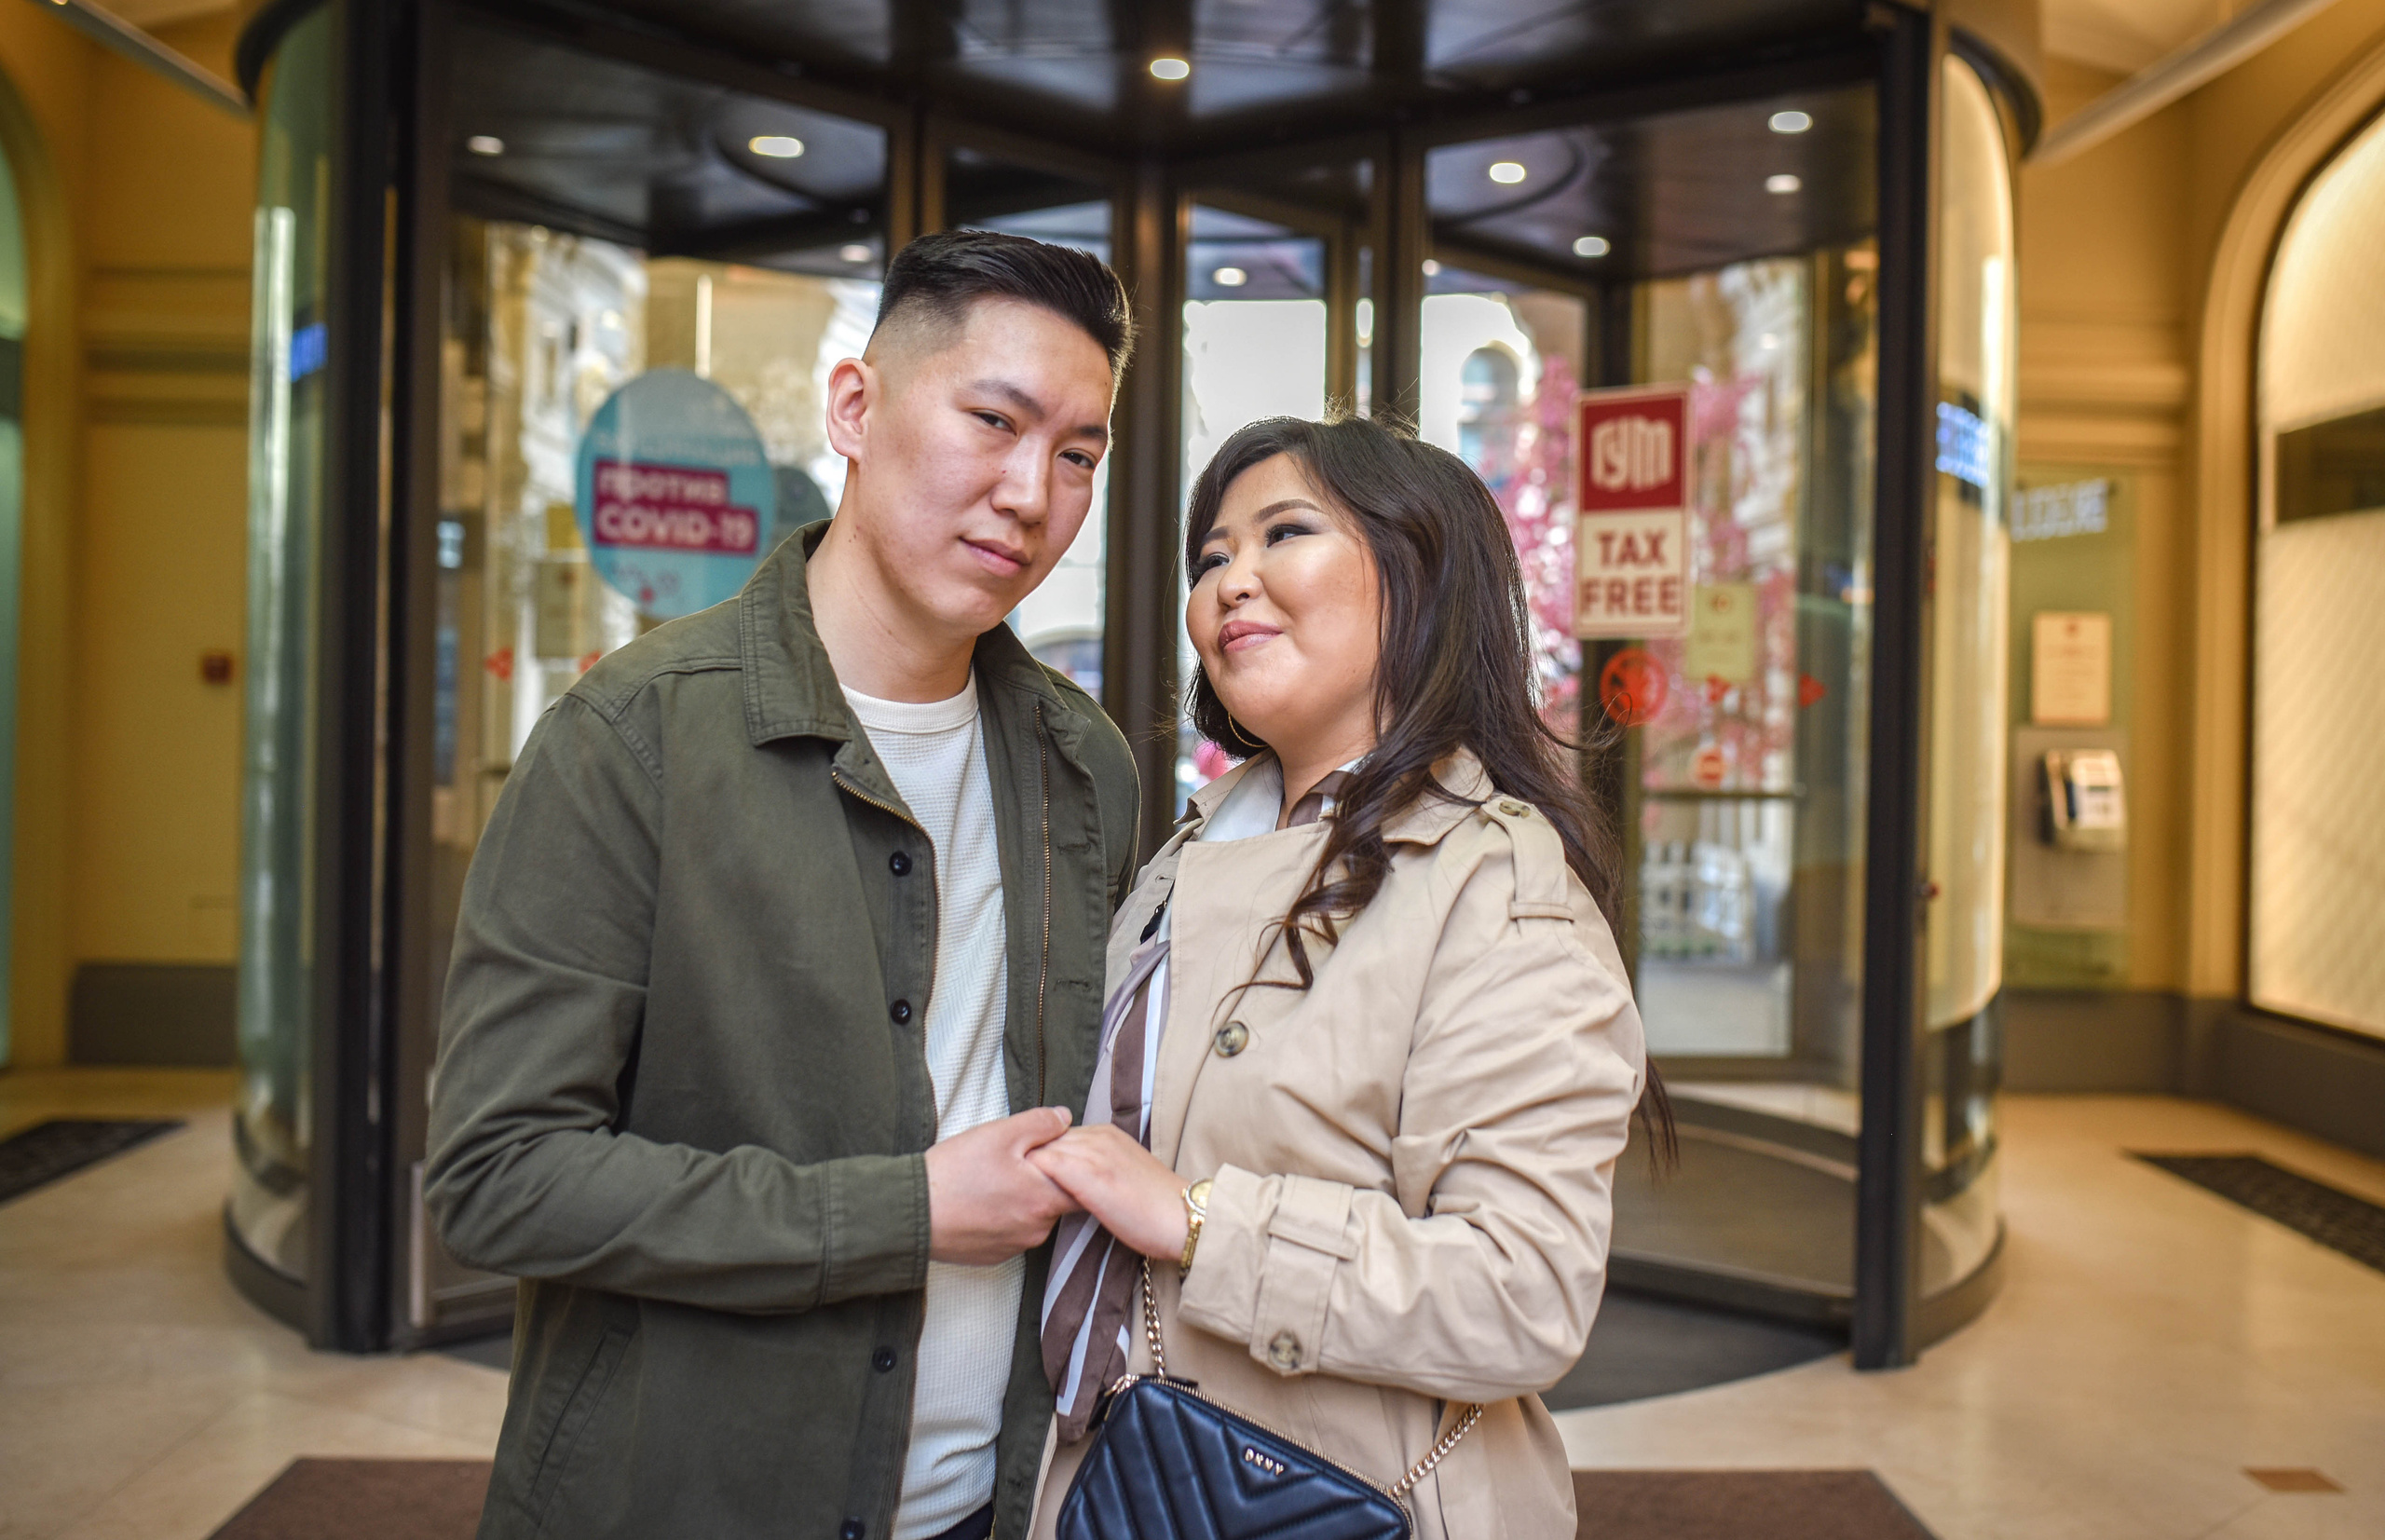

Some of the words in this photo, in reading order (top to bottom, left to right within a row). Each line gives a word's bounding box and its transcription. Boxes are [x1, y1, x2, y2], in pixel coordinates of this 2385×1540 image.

[597, 503, 755, 550] COVID-19
[1595, 529, 1668, 567] TAX
[1580, 577, 1680, 616] FREE
[1245, 1448, 1284, 1476] DKNY
